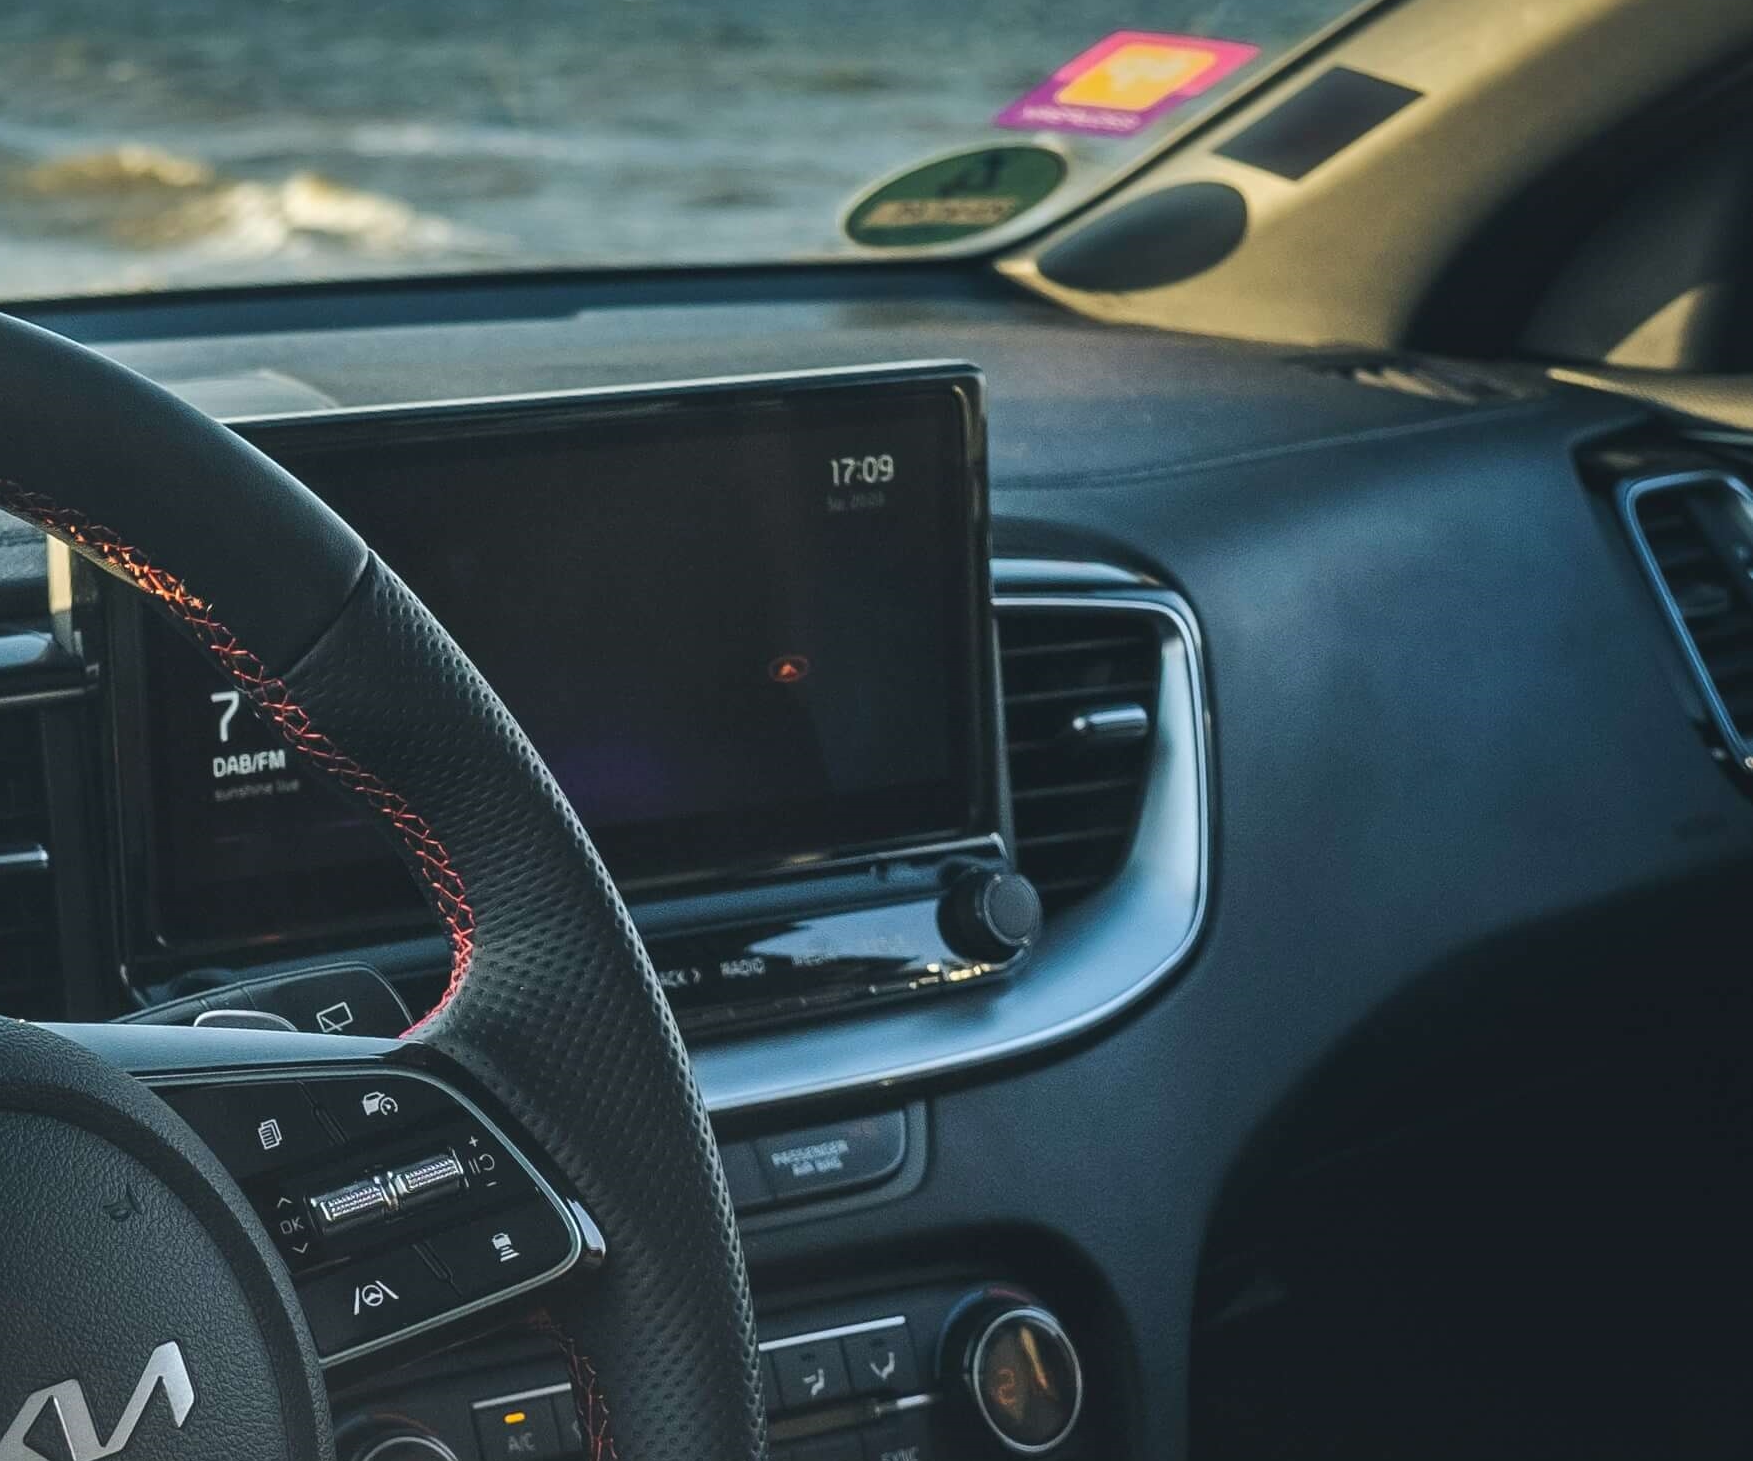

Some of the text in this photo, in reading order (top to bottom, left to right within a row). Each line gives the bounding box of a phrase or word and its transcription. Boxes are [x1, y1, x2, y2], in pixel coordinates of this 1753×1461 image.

[829, 453, 895, 488] 17:09
[211, 749, 287, 779] DAB/FM
[279, 1216, 305, 1236] OK
